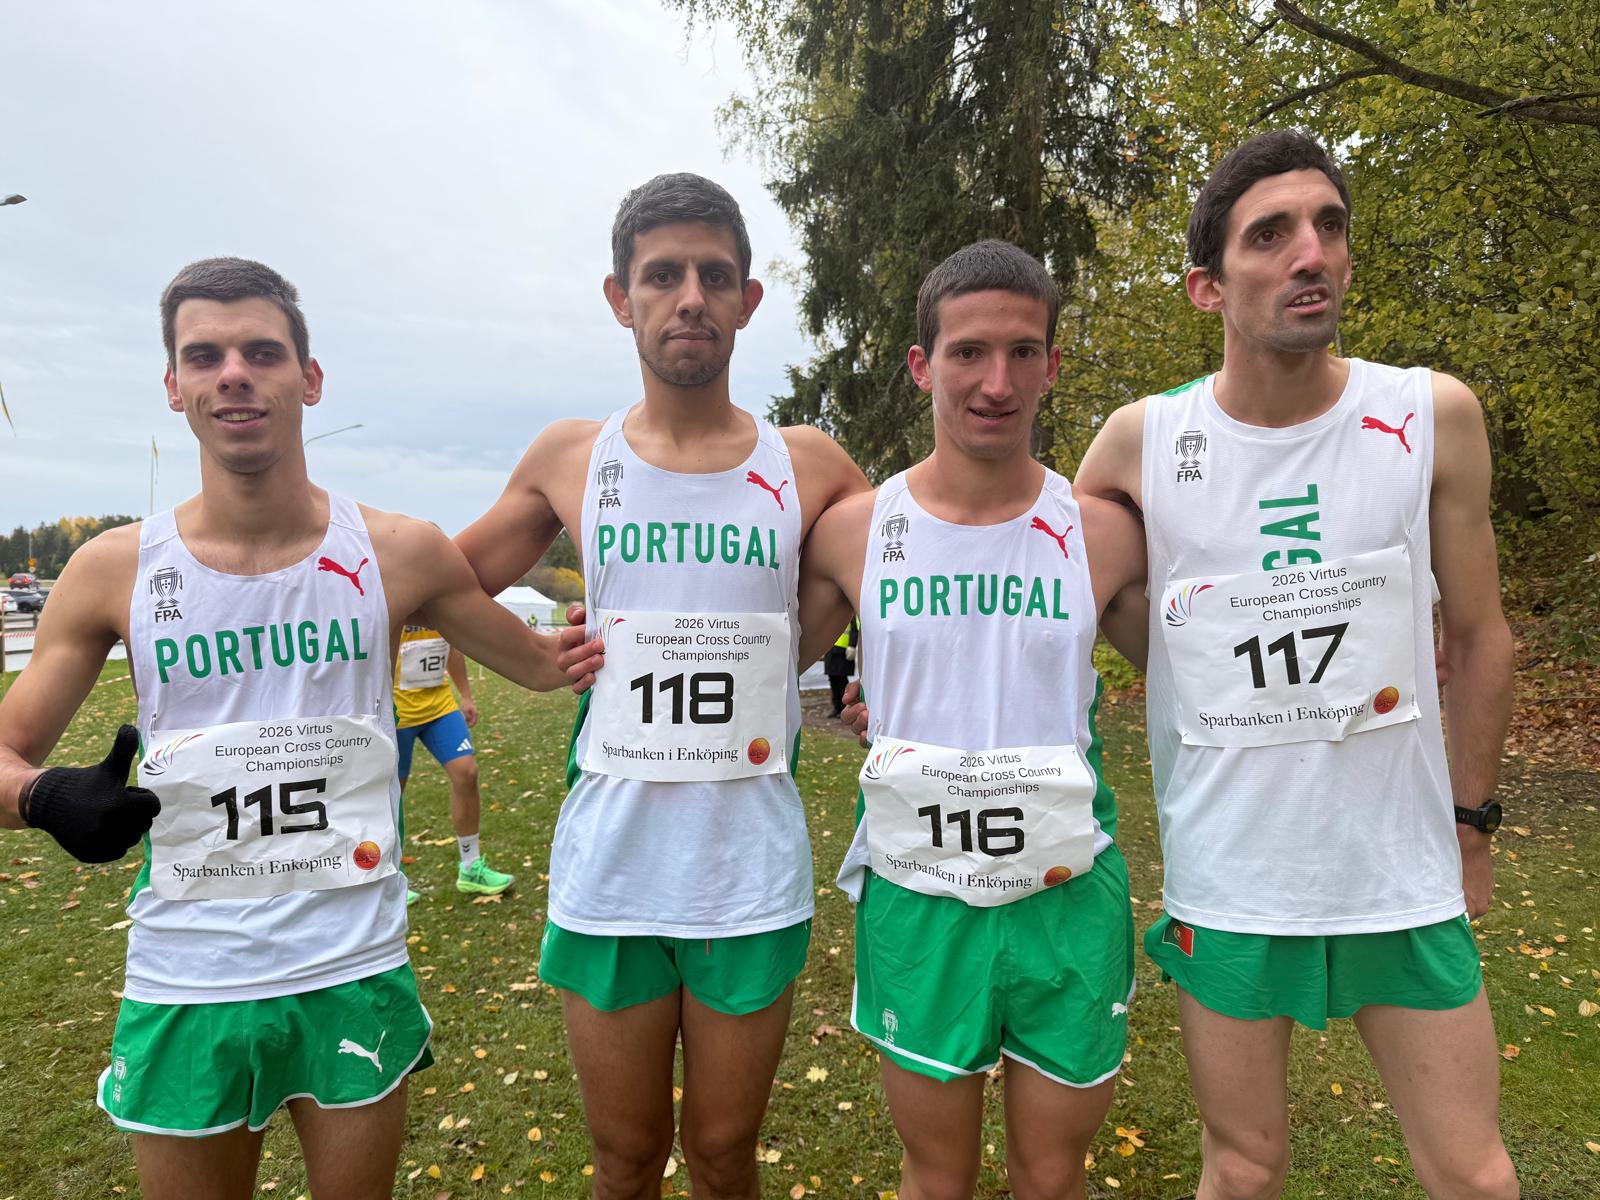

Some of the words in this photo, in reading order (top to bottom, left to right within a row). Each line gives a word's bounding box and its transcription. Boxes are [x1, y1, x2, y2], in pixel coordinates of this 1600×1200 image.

[1177, 467, 1203, 483] FPA
[598, 496, 622, 509] FPA
[598, 522, 780, 571] PORTUGAL
[882, 549, 906, 564] FPA
[1271, 571, 1307, 588] 2026
[1308, 566, 1348, 583] Virtus
[880, 574, 1070, 620] PORTUGAL
[1229, 591, 1297, 610] European
[1298, 585, 1340, 602] Cross
[1341, 575, 1388, 594] Country
[154, 608, 184, 624] FPA
[1261, 598, 1363, 623] Championships
[674, 618, 705, 629] 2026
[707, 618, 741, 630] Virtus
[154, 617, 369, 685] PORTUGAL
[635, 632, 693, 648] European
[695, 633, 731, 646] Cross
[732, 632, 772, 648] Country
[419, 655, 446, 673] 121
[661, 649, 750, 664] Championships
[1233, 621, 1351, 690] 117
[630, 671, 735, 726] 118
[1199, 711, 1284, 729] Sparbanken
[1286, 711, 1293, 722] i
[1295, 702, 1367, 724] Enköping
[258, 725, 294, 739] 2026
[296, 722, 334, 736] Virtus
[215, 743, 281, 759] European
[284, 740, 323, 755] Cross
[324, 735, 373, 751] Country
[601, 740, 666, 761] Sparbanken
[668, 748, 673, 761] i
[676, 745, 740, 765] Enköping
[245, 753, 344, 774] Championships
[959, 754, 986, 768] 2026
[986, 753, 1023, 767] Virtus
[921, 764, 979, 783] European
[980, 769, 1018, 783] Cross
[1017, 765, 1062, 779] Country
[946, 783, 1041, 800] Championships
[210, 776, 329, 842] 115
[917, 803, 1026, 858] 116
[172, 862, 257, 882] Sparbanken
[258, 864, 265, 877] i
[268, 855, 343, 876] Enköping
[885, 853, 956, 884] Sparbanken
[958, 873, 963, 886] i
[966, 873, 1033, 893] Enköping
